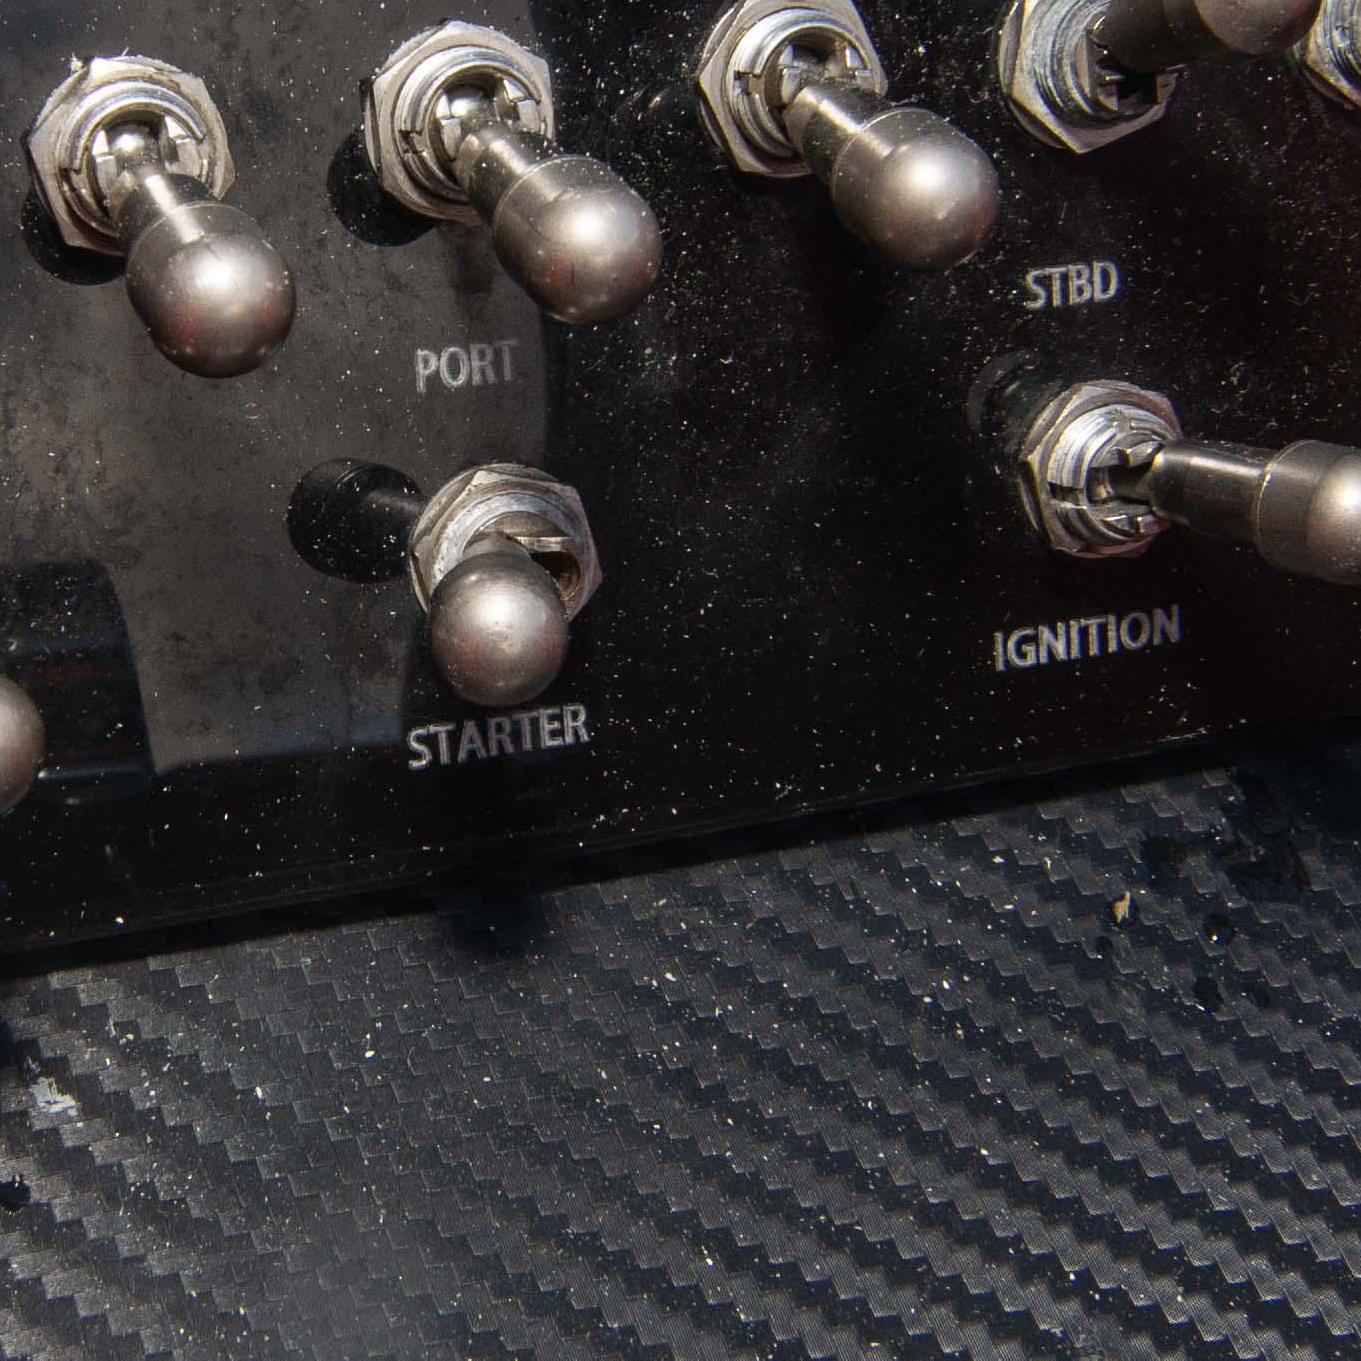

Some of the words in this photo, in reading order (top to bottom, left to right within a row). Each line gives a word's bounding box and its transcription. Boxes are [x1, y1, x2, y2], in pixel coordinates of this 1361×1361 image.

[1024, 259, 1121, 311] STBD
[414, 338, 520, 394] PORT
[993, 604, 1182, 674] IGNITION
[405, 703, 591, 771] STARTER
